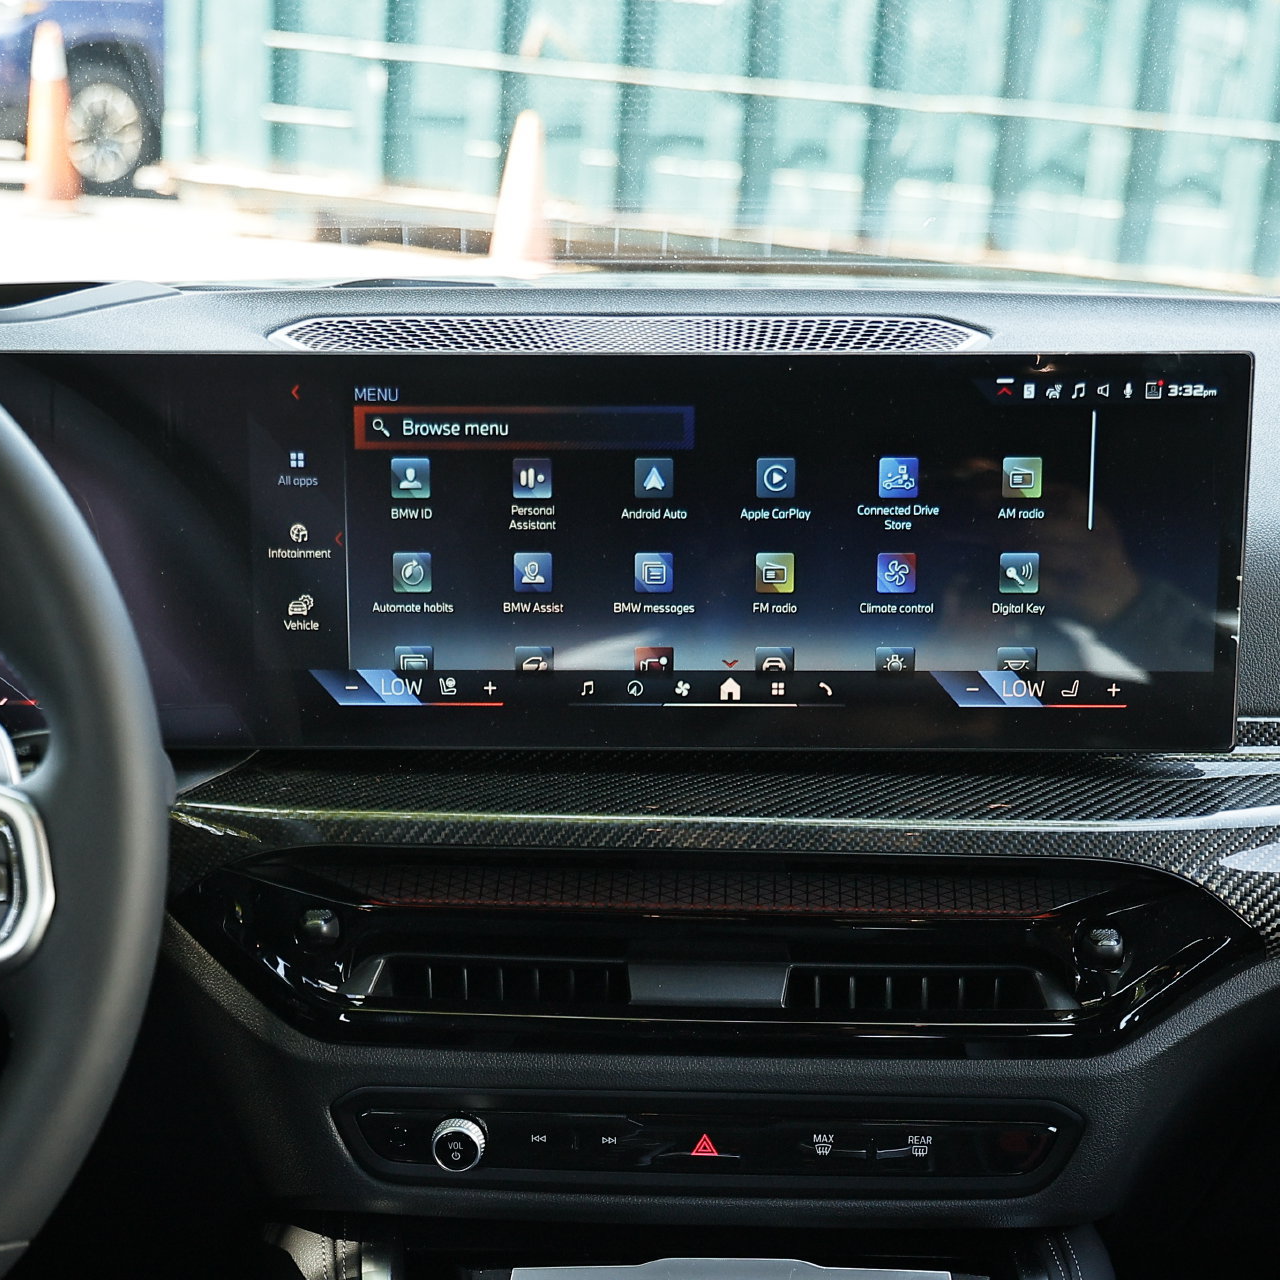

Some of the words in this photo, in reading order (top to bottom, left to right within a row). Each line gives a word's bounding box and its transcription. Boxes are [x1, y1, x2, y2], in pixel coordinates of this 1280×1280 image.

[354, 388, 399, 402] MENU
[1168, 384, 1217, 398] 3:32pm
[402, 420, 460, 436] Browse
[465, 422, 509, 436] menu
[278, 475, 291, 486] All
[292, 477, 318, 489] apps
[391, 508, 420, 520] BMW
[421, 508, 433, 520] ID
[511, 504, 555, 517] Personal
[621, 508, 658, 520] Android
[662, 508, 687, 520] Auto
[740, 508, 769, 521] Apple
[771, 508, 811, 521] CarPlay
[857, 504, 911, 517] Connected
[913, 505, 940, 517] Drive
[998, 508, 1015, 519] AM
[1018, 508, 1044, 520] radio
[508, 519, 556, 531] Assistant
[884, 519, 912, 531] Store
[268, 547, 331, 560] Infotainment
[372, 602, 420, 614] Automate
[422, 602, 454, 614] habits
[503, 602, 531, 614] BMW
[533, 602, 563, 614] Assist
[613, 603, 641, 614] BMW
[643, 604, 695, 616] messages
[752, 603, 768, 614] FM
[772, 603, 797, 614] radio
[859, 602, 897, 614] Climate
[899, 602, 934, 614] control
[992, 602, 1025, 616] Digital
[1027, 602, 1045, 616] Key
[283, 619, 319, 631] Vehicle
[381, 678, 422, 697] LOW
[1002, 679, 1045, 698] LOW
[813, 1134, 835, 1143] MAX
[908, 1136, 932, 1145] REAR
[448, 1141, 464, 1150] VOL
